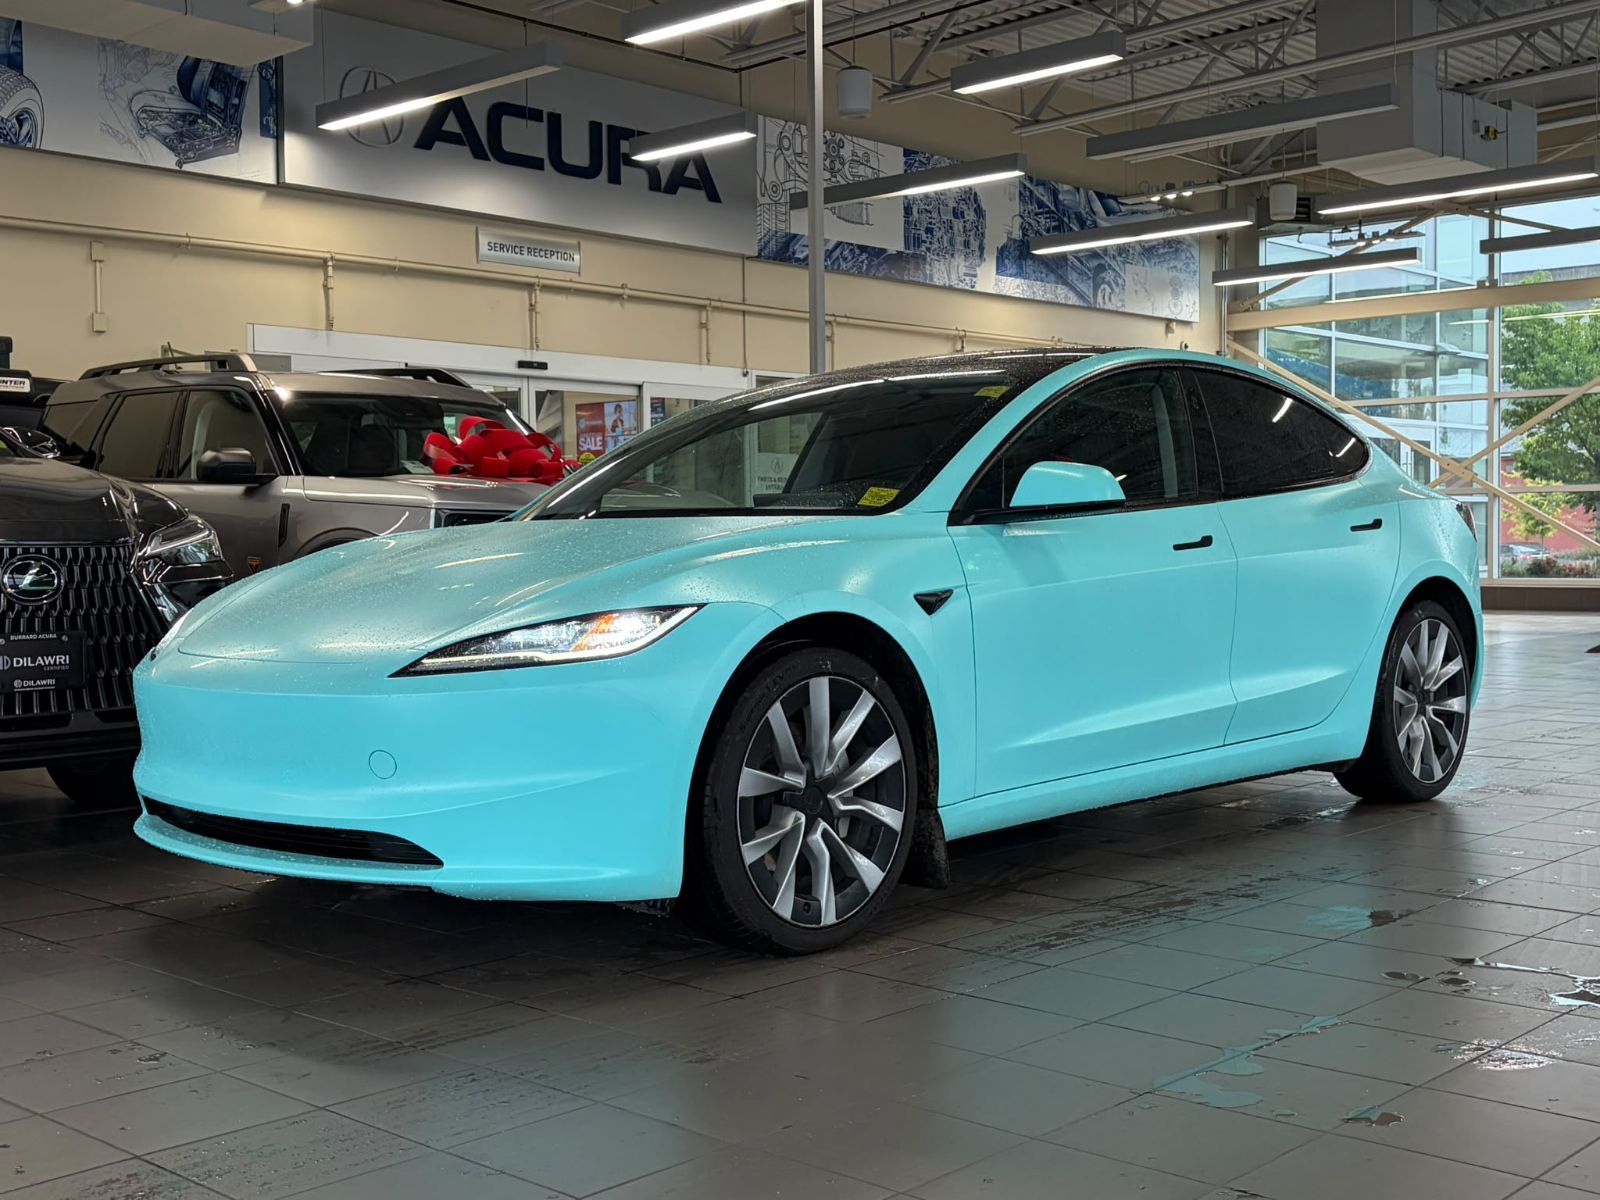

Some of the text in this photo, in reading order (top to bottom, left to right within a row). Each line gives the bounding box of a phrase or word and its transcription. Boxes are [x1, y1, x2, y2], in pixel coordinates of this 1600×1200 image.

[413, 96, 723, 204] ACURA
[487, 241, 575, 262] SERVICE RECEPTION
[579, 436, 602, 451] SALE
[13, 655, 69, 667] DILAWRI
